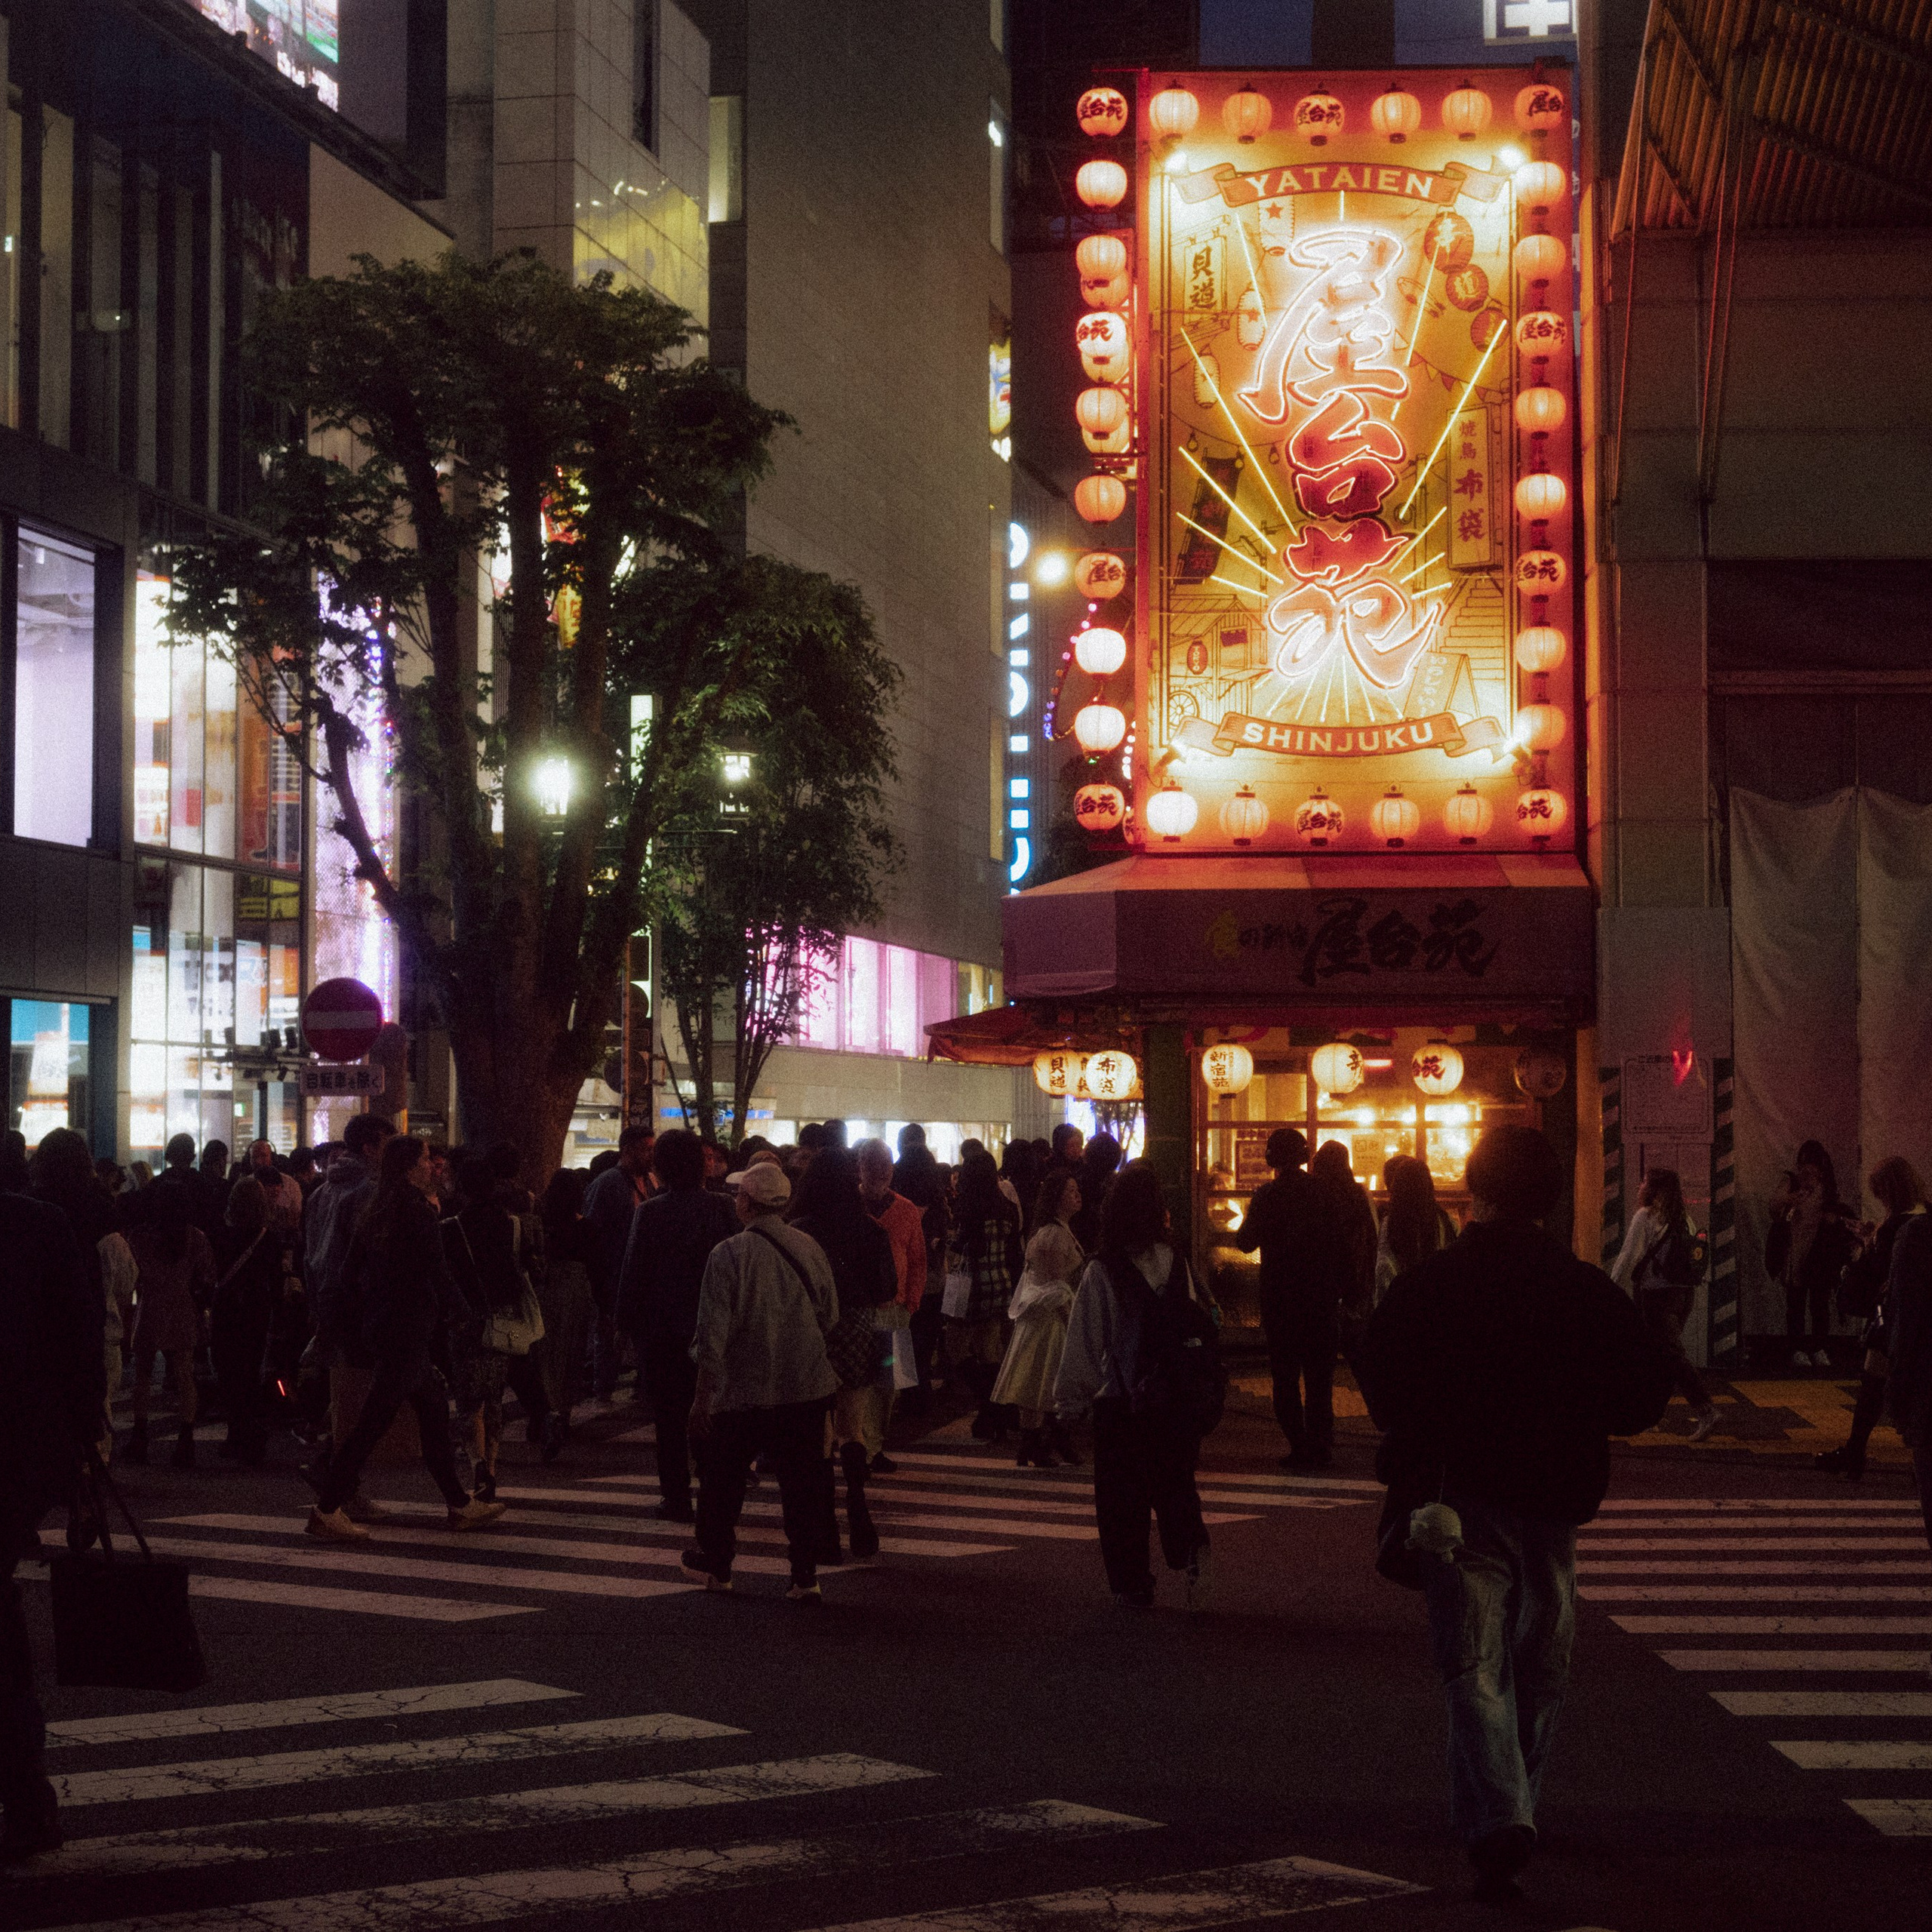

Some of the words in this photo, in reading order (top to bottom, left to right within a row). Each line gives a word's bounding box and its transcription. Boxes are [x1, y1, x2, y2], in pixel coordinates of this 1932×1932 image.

[1296, 102, 1341, 127] 屋台苑
[1245, 166, 1434, 198] YATAIEN
[1190, 245, 1217, 310] 貝道
[1238, 228, 1441, 690] 屋台苑
[1242, 721, 1434, 752] SHINJUKU
[1297, 810, 1343, 835] 屋台苑
[306, 1072, 380, 1089] 自転車を除く
[1050, 1057, 1067, 1088] 貝道
[1096, 1057, 1116, 1094] 布袋
[1210, 1051, 1229, 1088] 新宿苑
